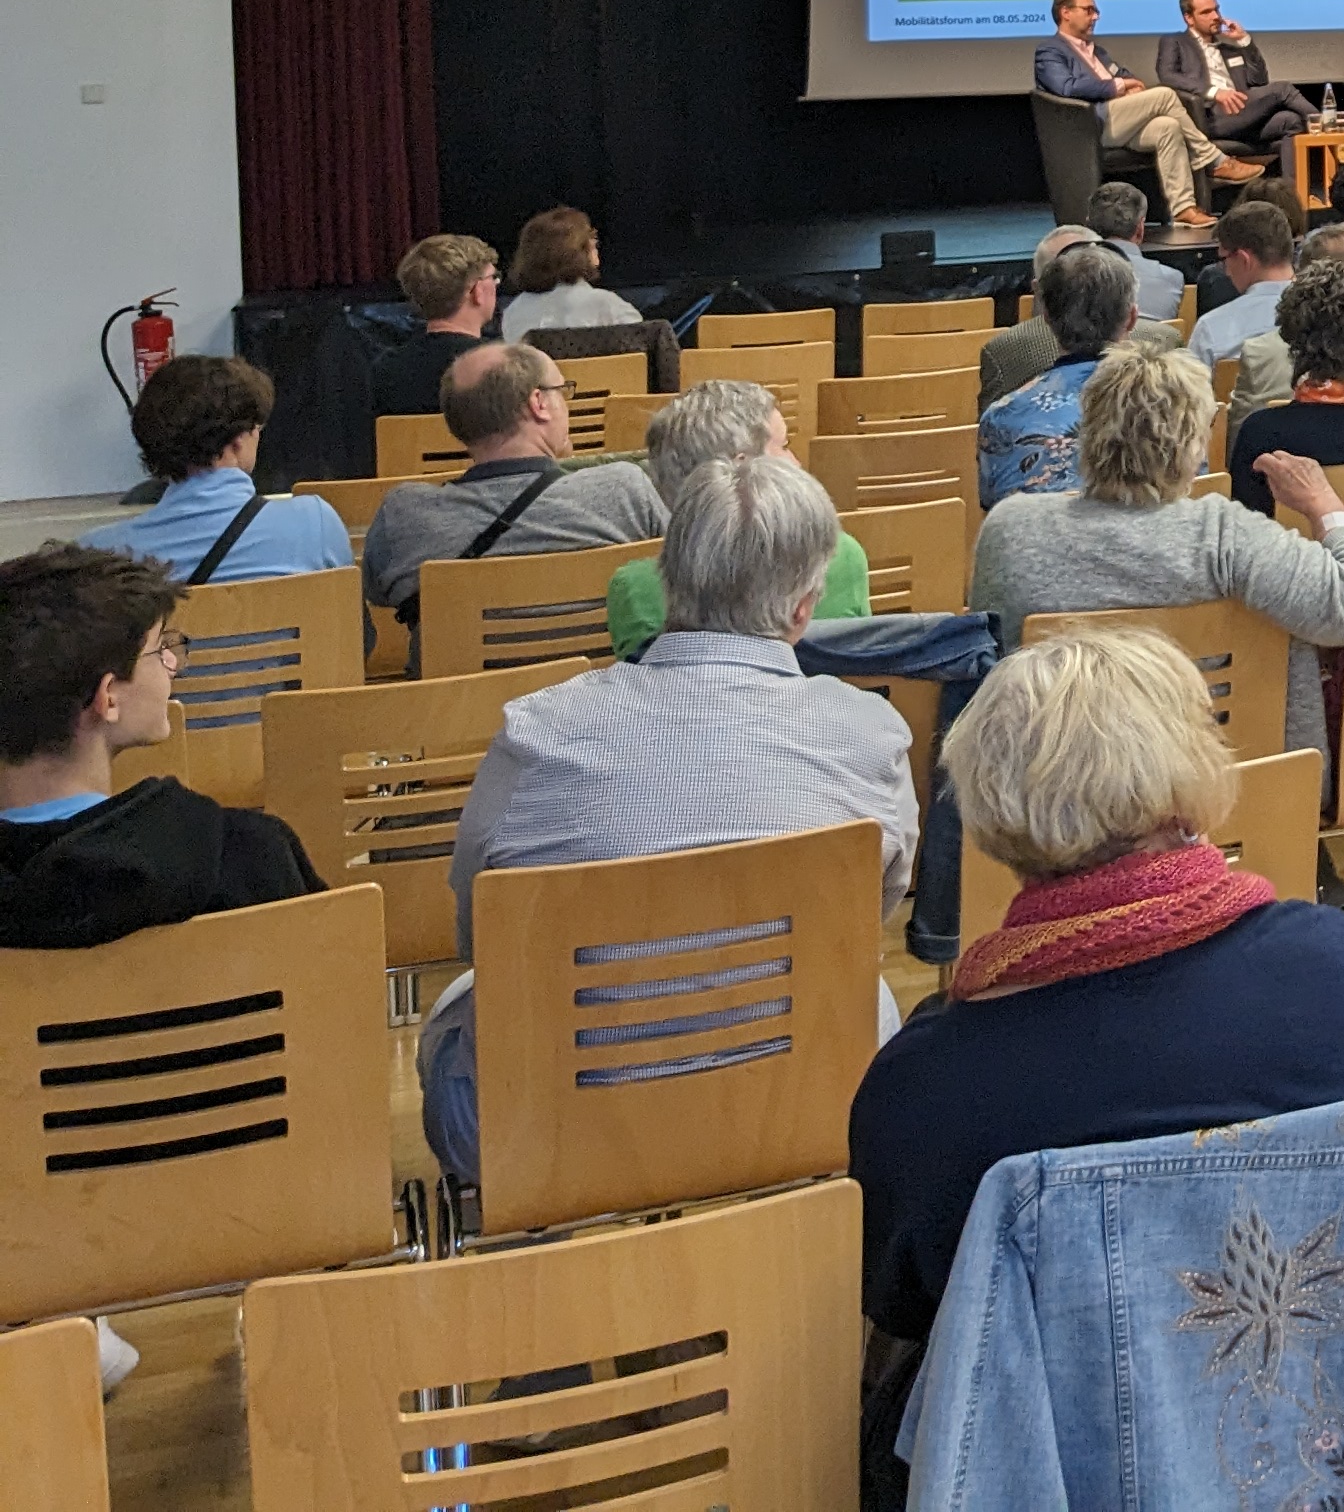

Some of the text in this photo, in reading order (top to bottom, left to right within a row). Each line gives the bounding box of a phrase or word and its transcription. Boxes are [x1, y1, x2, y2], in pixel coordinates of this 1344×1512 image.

[895, 13, 1047, 27] Mobilitätsforum am 08.05.2024
